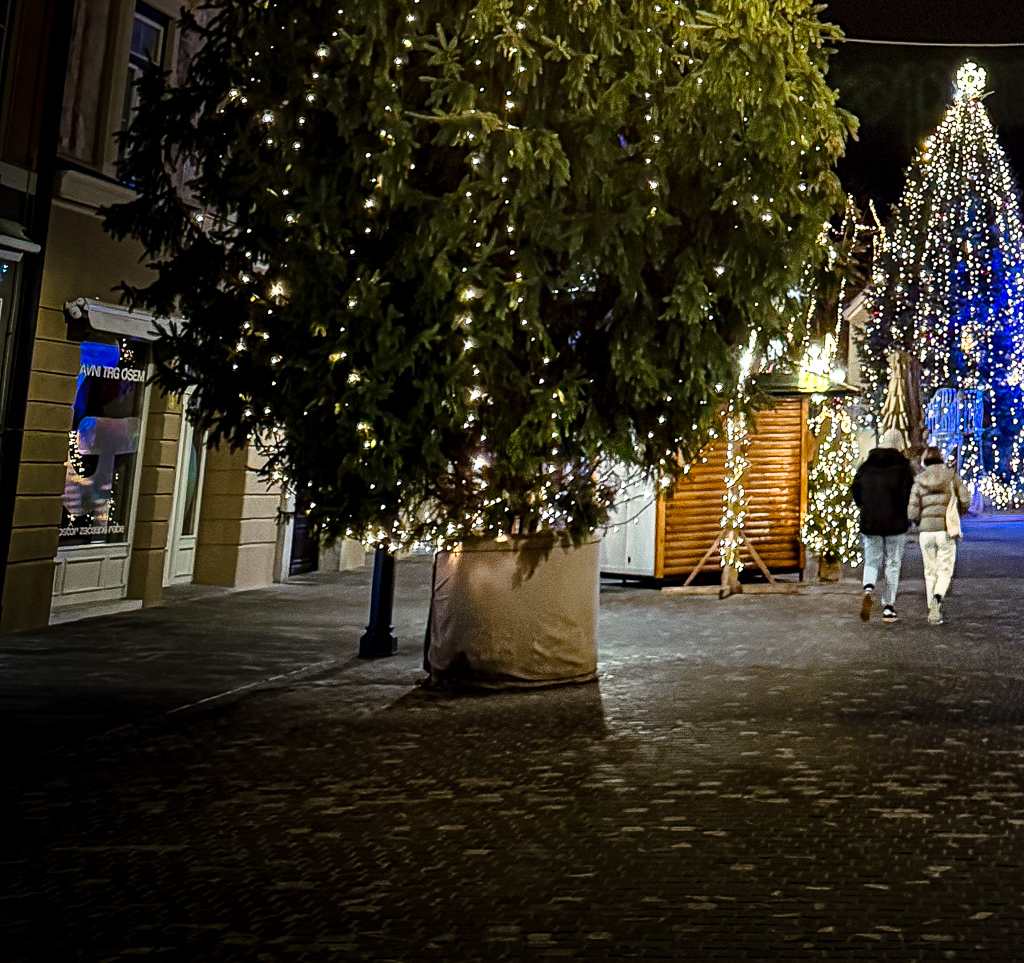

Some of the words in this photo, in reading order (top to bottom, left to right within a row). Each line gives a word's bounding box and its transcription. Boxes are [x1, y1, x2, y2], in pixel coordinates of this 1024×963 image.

[80, 364, 101, 378] AVNI
[103, 366, 120, 379] TRG
[121, 367, 146, 382] OSEM
